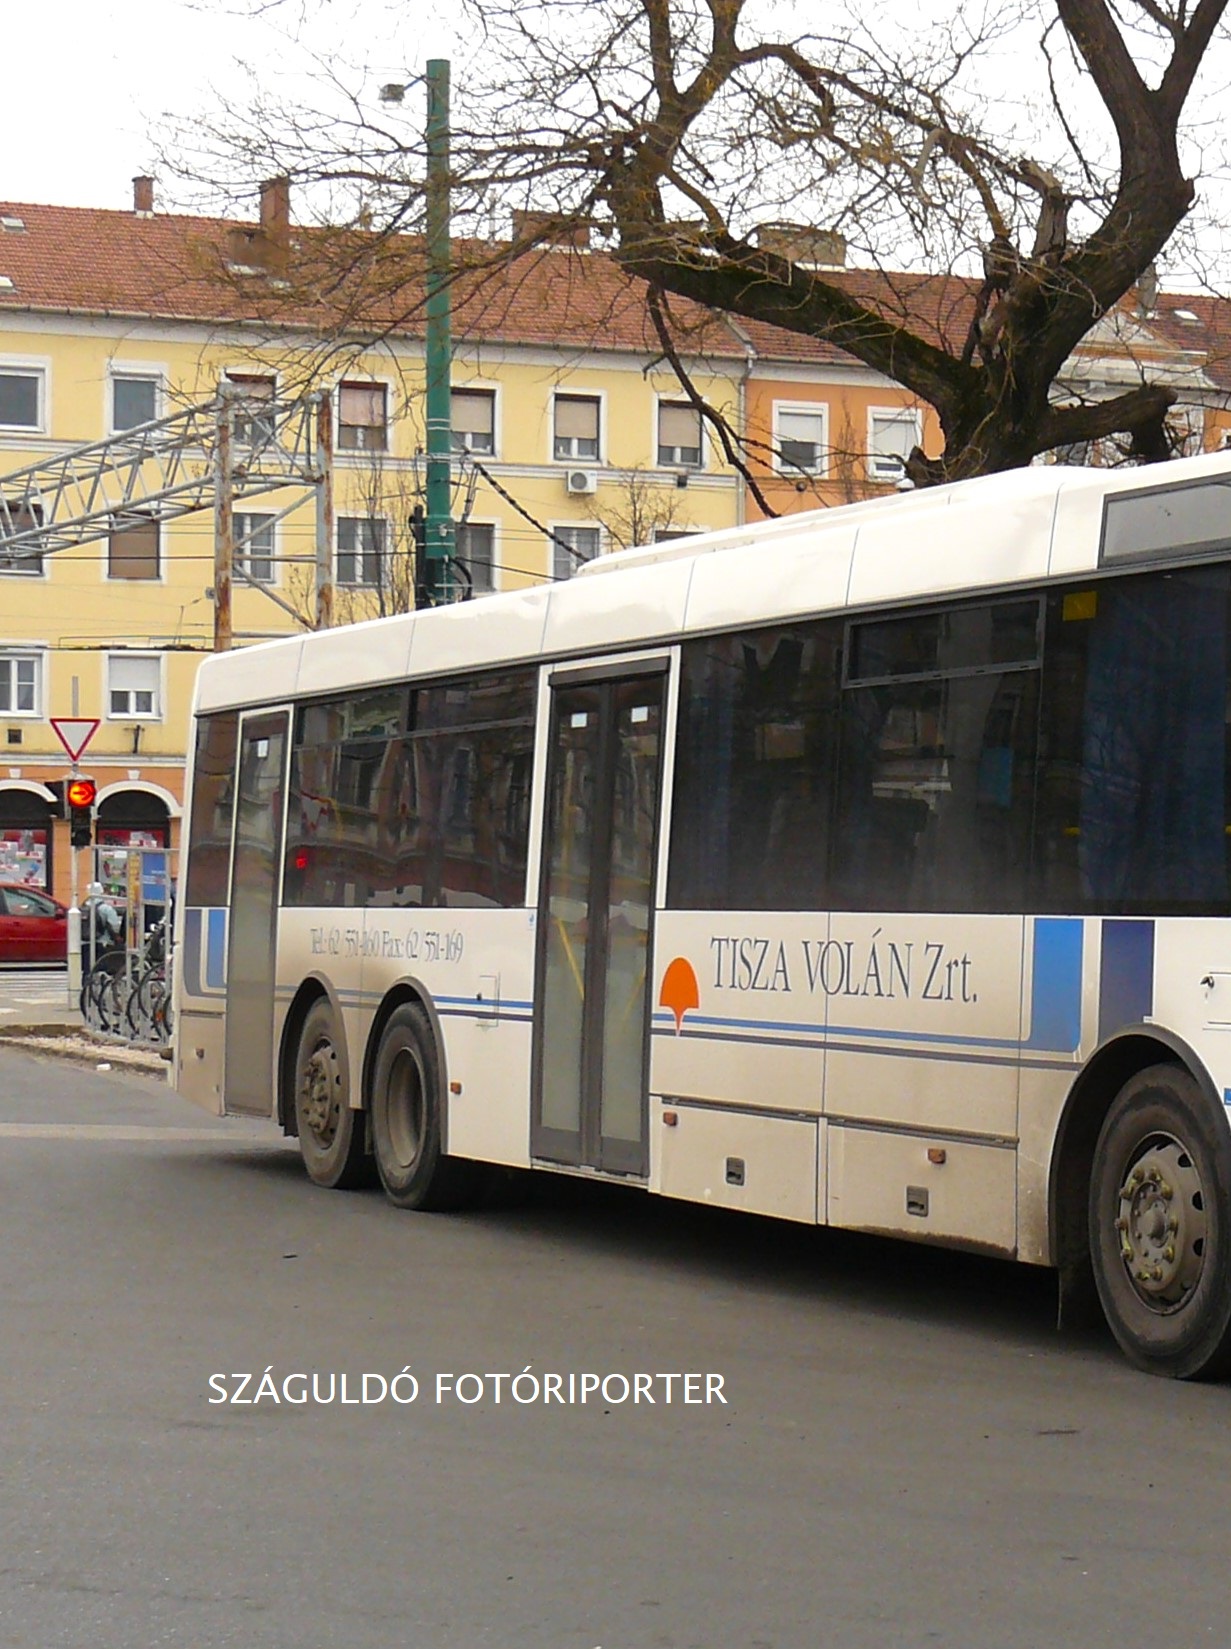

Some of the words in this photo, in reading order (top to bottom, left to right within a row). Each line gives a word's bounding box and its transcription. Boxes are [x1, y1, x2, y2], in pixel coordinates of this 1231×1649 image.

[710, 936, 792, 993] TISZA
[801, 927, 913, 999] VOLÁN
[922, 940, 978, 1003] Zrt.
